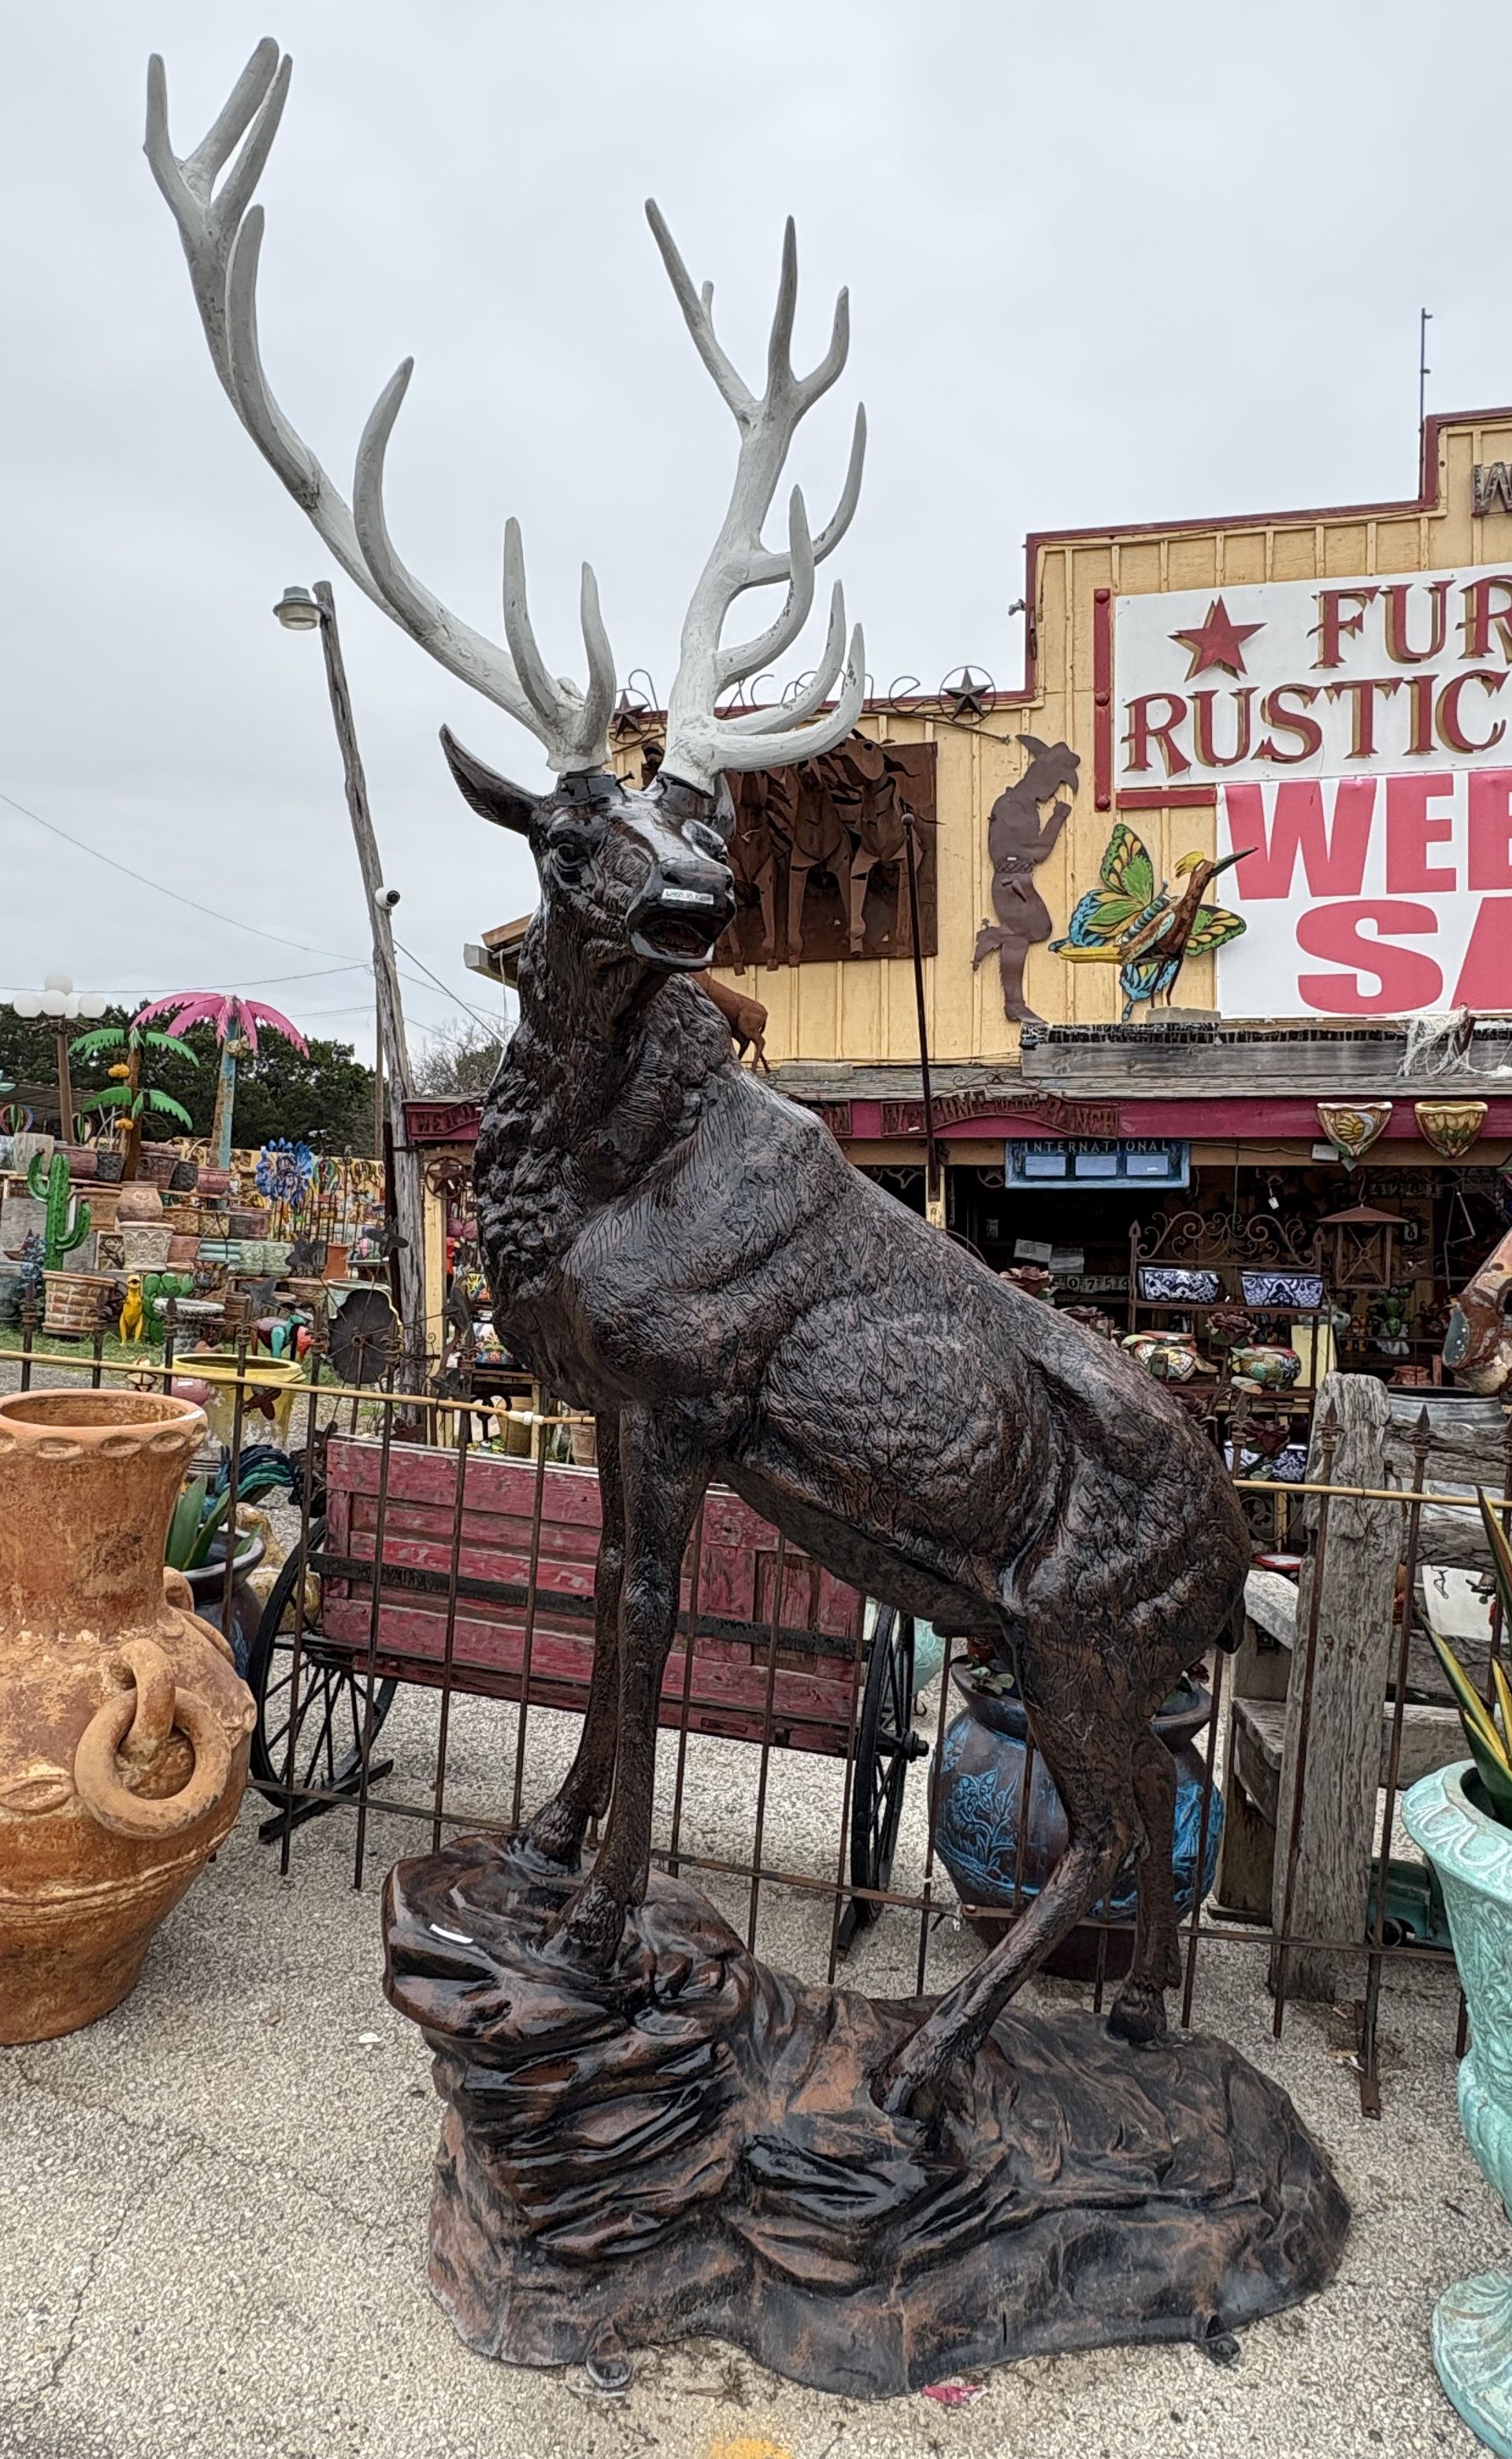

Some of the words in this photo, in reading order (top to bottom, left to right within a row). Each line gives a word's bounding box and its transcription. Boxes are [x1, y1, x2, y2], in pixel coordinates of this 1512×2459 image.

[1121, 669, 1510, 777] RUSTIC
[1047, 1094, 1115, 1137] RANCH
[1025, 1140, 1169, 1153] INTERNATIONAL
